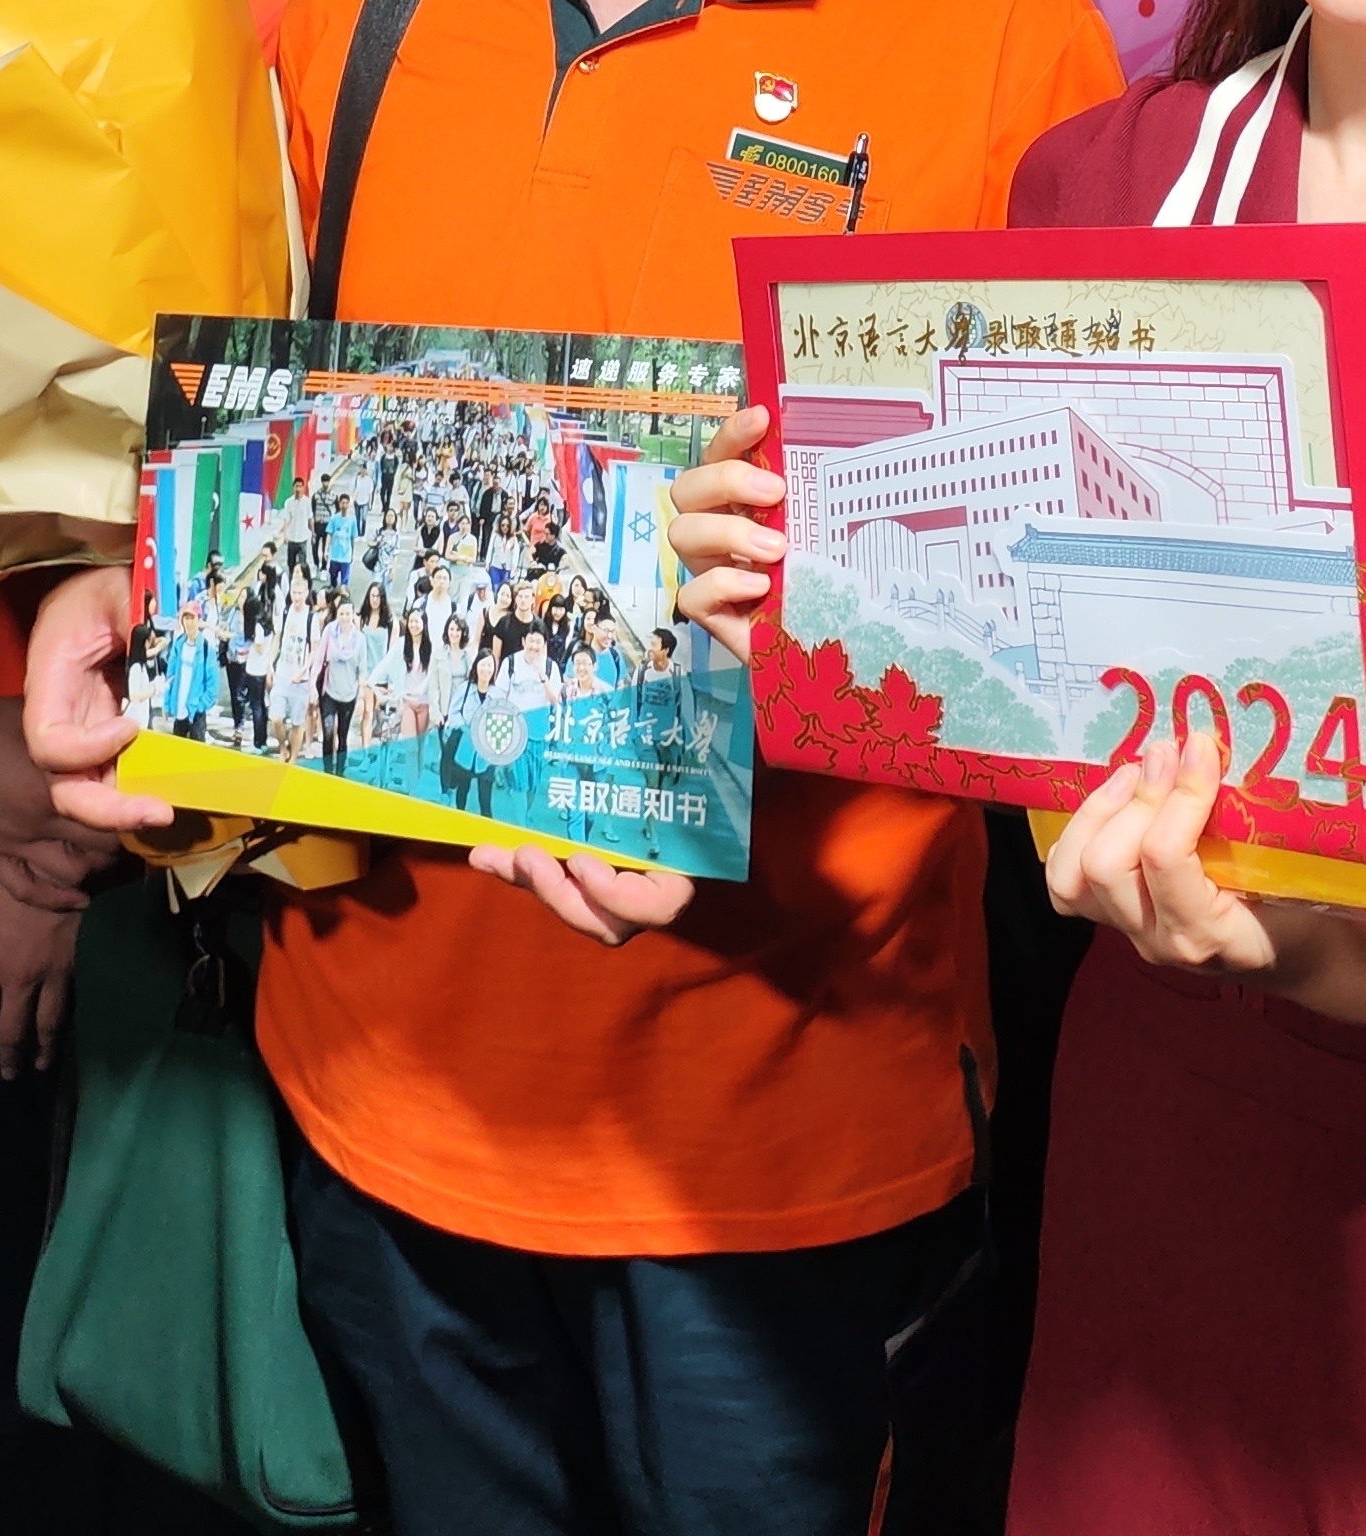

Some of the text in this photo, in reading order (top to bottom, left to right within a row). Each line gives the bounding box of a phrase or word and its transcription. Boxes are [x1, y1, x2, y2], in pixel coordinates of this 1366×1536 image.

[765, 151, 840, 184] 0800160
[201, 363, 293, 413] EMS
[569, 357, 741, 389] 速递服务专家
[547, 775, 708, 827] 录取通知书
